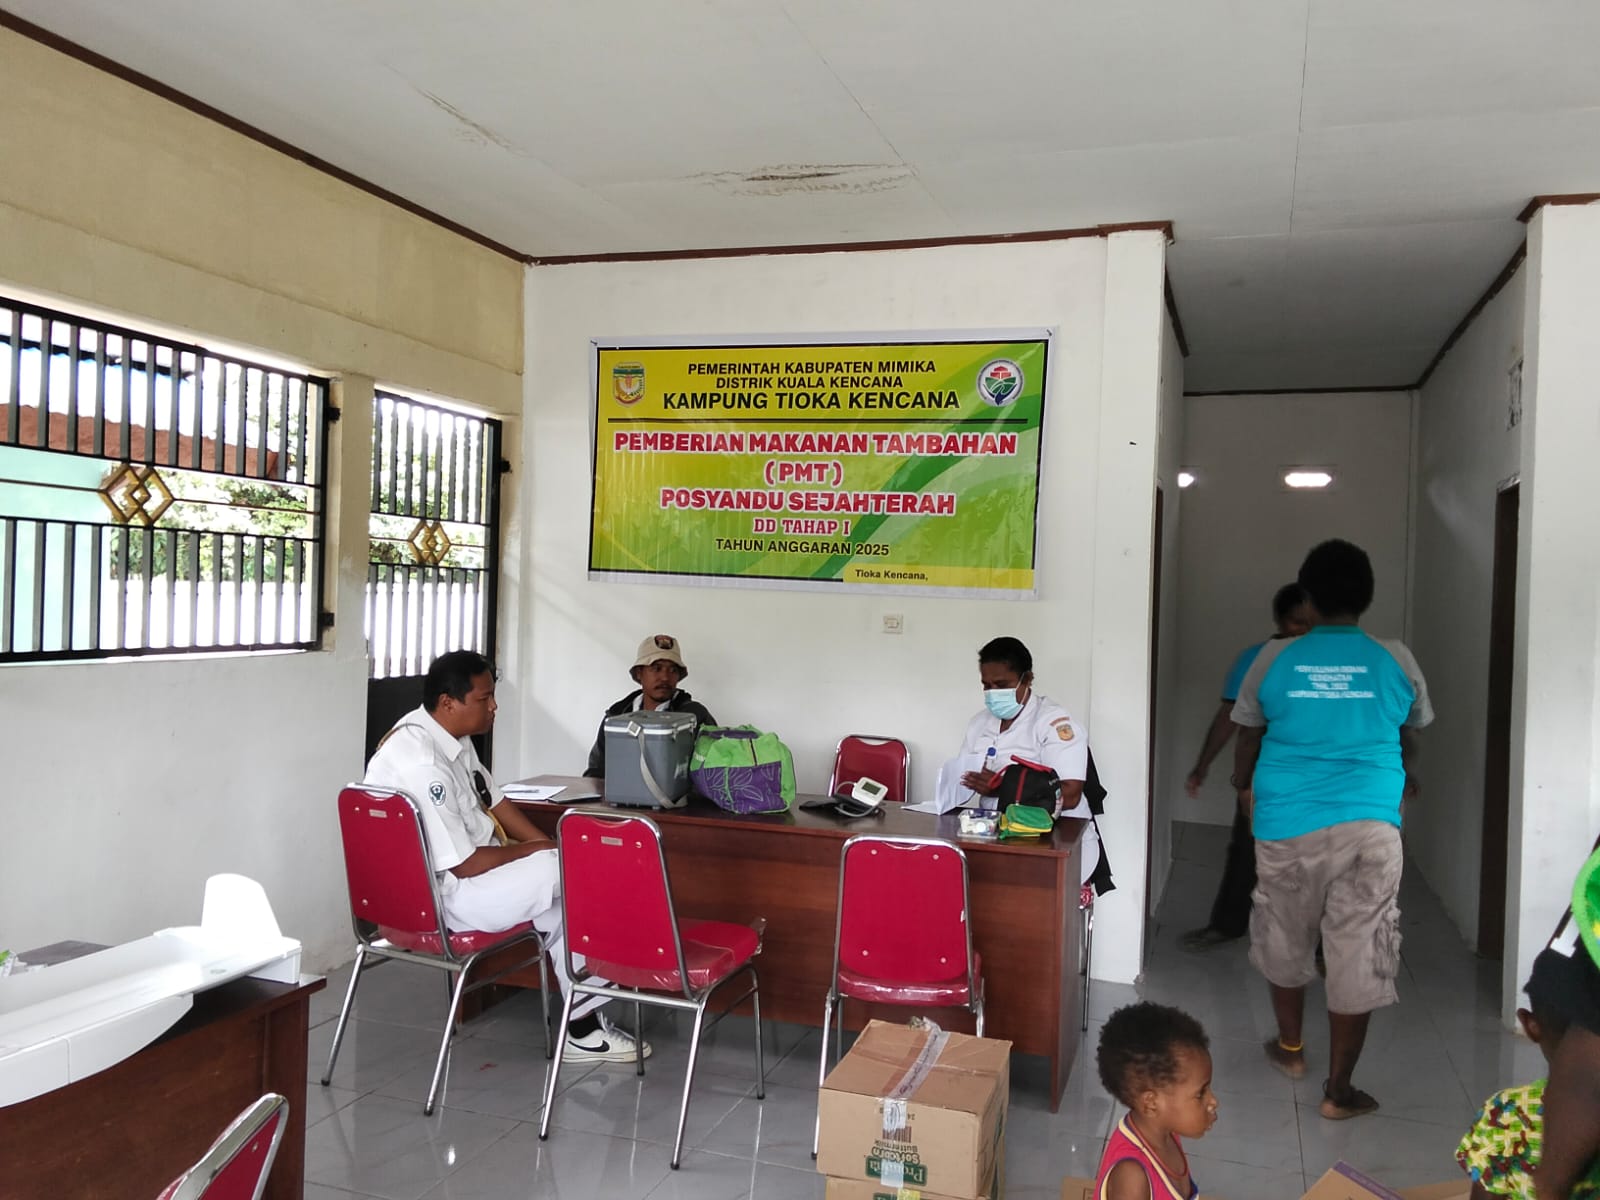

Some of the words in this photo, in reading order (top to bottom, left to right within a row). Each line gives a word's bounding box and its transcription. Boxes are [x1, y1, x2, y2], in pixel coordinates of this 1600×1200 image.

[687, 362, 780, 375] PEMERINTAH
[784, 361, 873, 374] KABUPATEN
[877, 360, 936, 373] MIMIKA
[716, 377, 773, 389] DISTRIK
[777, 376, 825, 388] KUALA
[829, 376, 903, 388] KENCANA
[663, 392, 768, 410] KAMPUNG
[775, 392, 841, 409] TIOKA
[848, 391, 960, 409] KENCANA
[614, 432, 744, 452] PEMBERIAN
[749, 433, 868, 454] MAKANAN
[872, 434, 1017, 455] TAMBAHAN
[660, 488, 785, 511] POSYANDU
[788, 491, 956, 515] SEJAHTERAH
[753, 518, 777, 533] DD
[781, 519, 838, 535] TAHAP
[843, 520, 850, 535] I
[716, 538, 764, 552] TAHUN
[767, 540, 851, 554] ANGGARAN
[855, 543, 889, 556] 2025
[854, 569, 881, 579] Tioka
[883, 570, 928, 581] Kencana,
